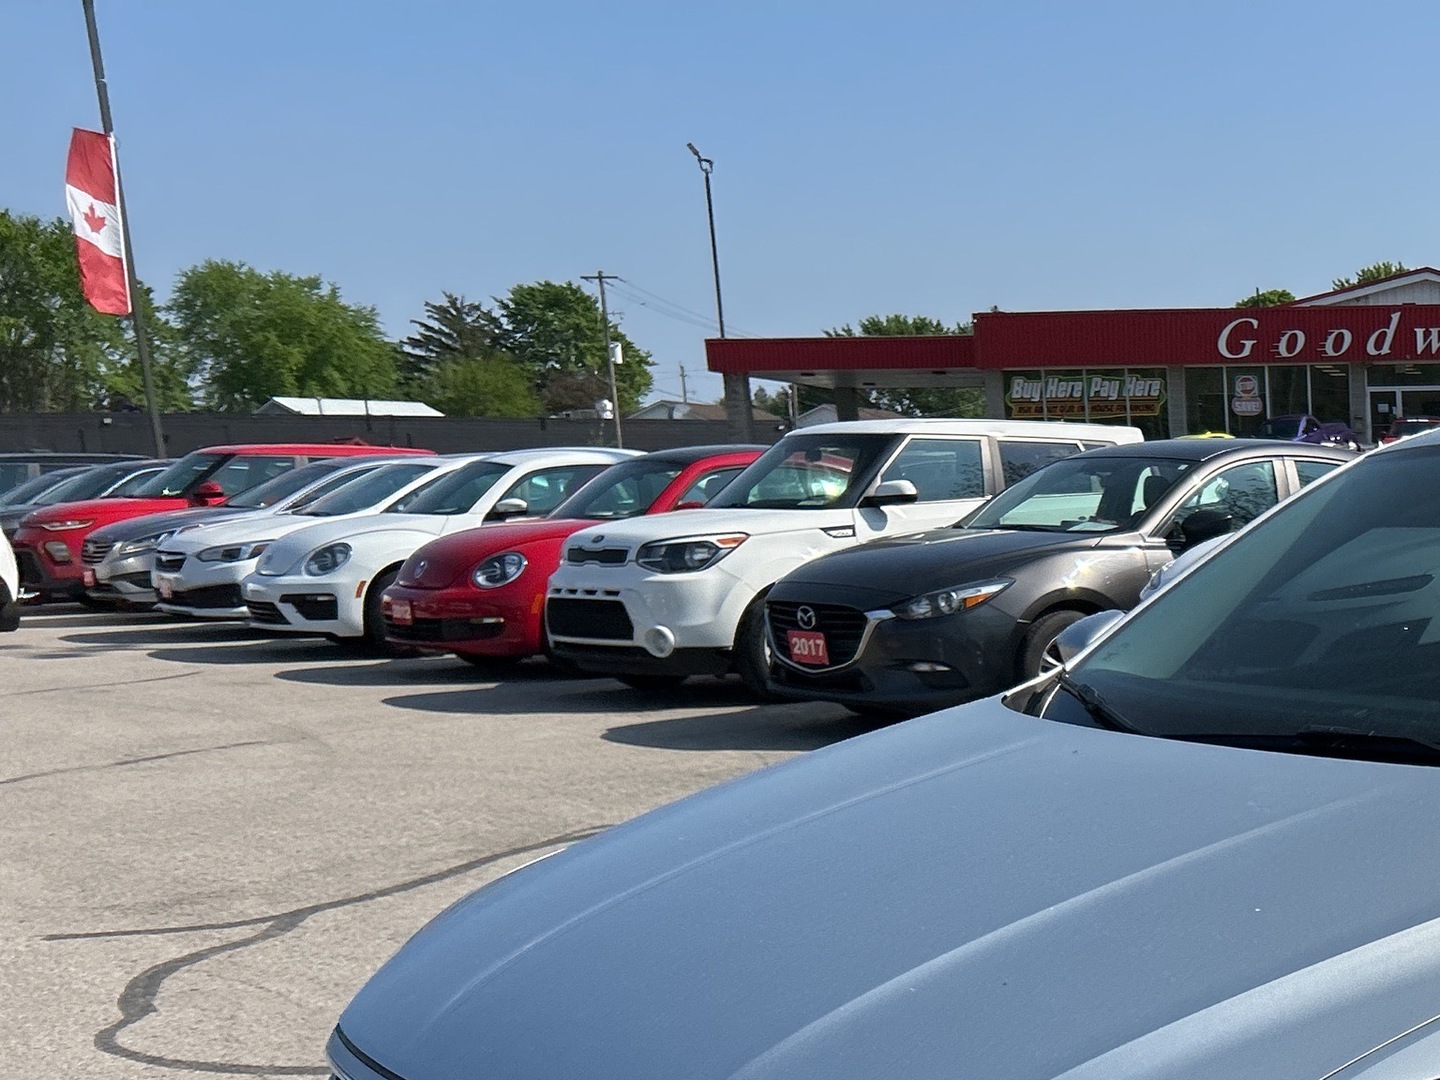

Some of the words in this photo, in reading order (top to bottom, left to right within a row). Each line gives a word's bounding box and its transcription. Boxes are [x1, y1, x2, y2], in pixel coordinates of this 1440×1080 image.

[1012, 379, 1042, 402] Buy
[1046, 377, 1083, 398] Here
[1089, 377, 1120, 400] Pay
[1123, 376, 1161, 397] Here
[1116, 403, 1156, 413] FINNCING
[791, 637, 825, 656] 2017
